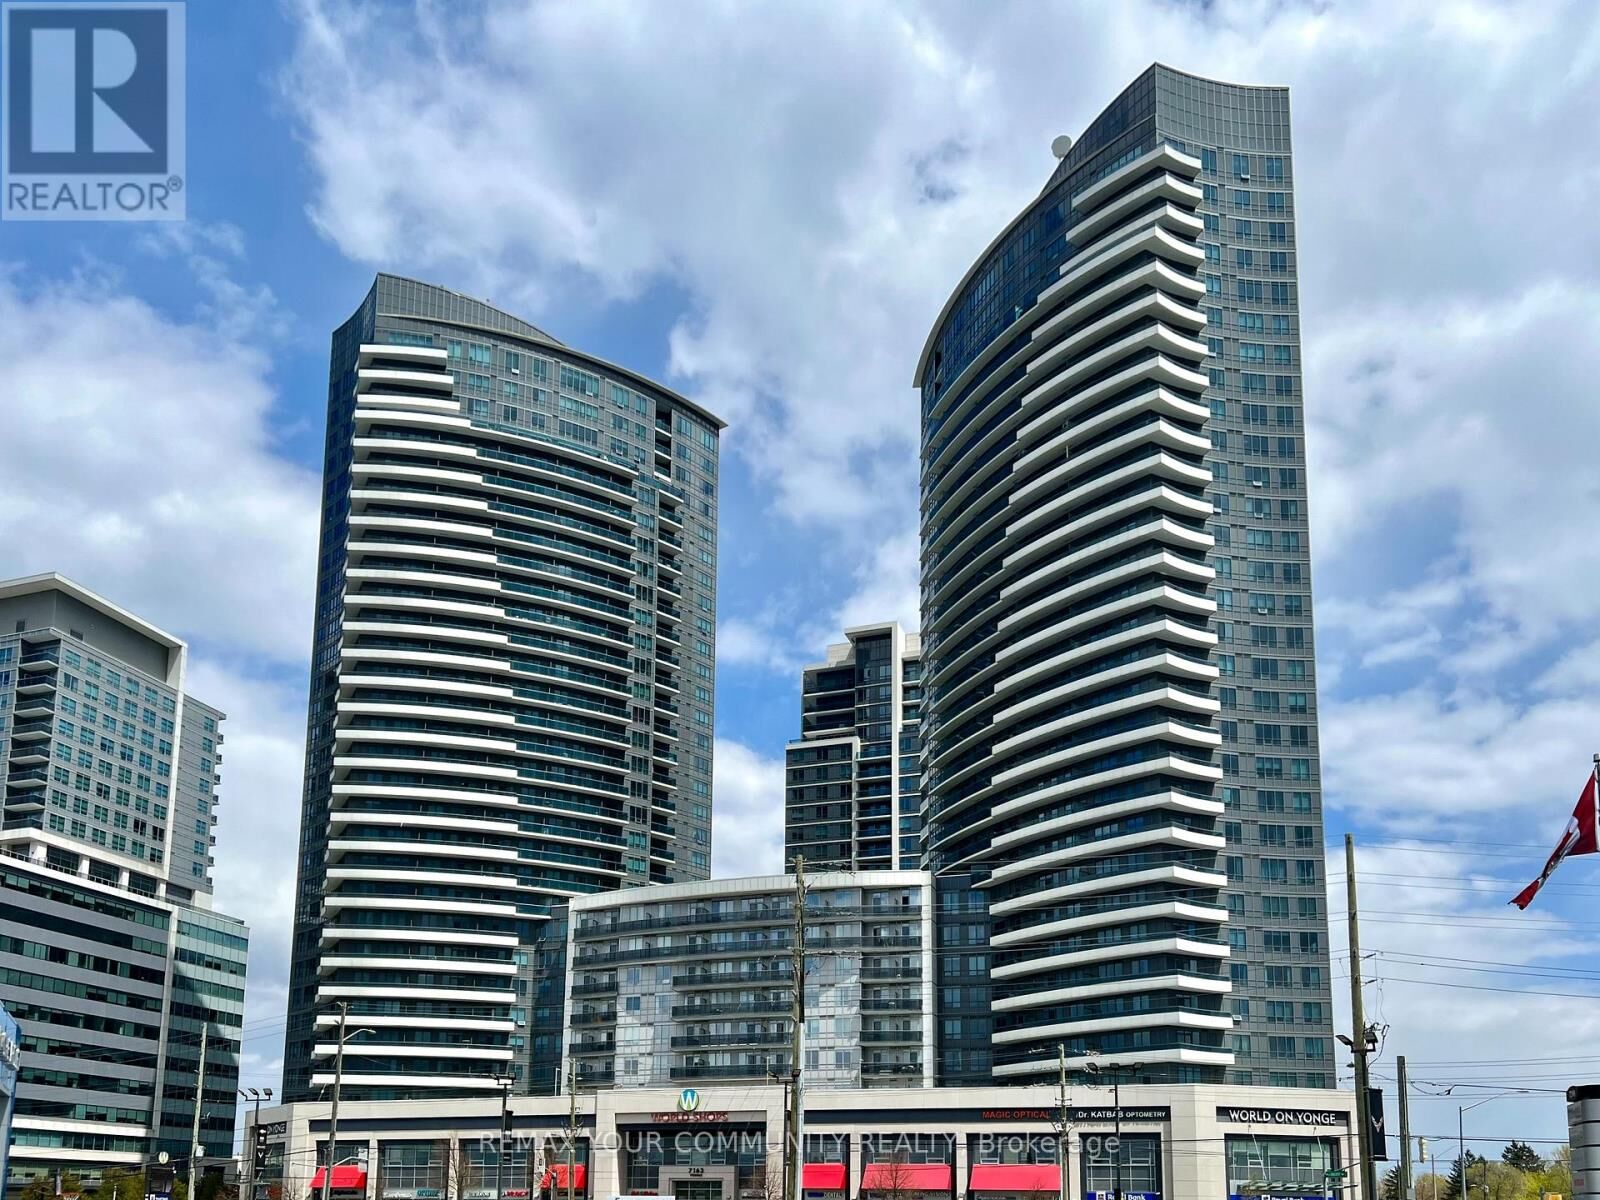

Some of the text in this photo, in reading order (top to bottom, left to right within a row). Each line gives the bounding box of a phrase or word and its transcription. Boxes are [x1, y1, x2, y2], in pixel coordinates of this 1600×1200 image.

[982, 1110, 1050, 1119] MAGIC OPTICAL
[1229, 1109, 1336, 1124] WORLD ON YONGE
